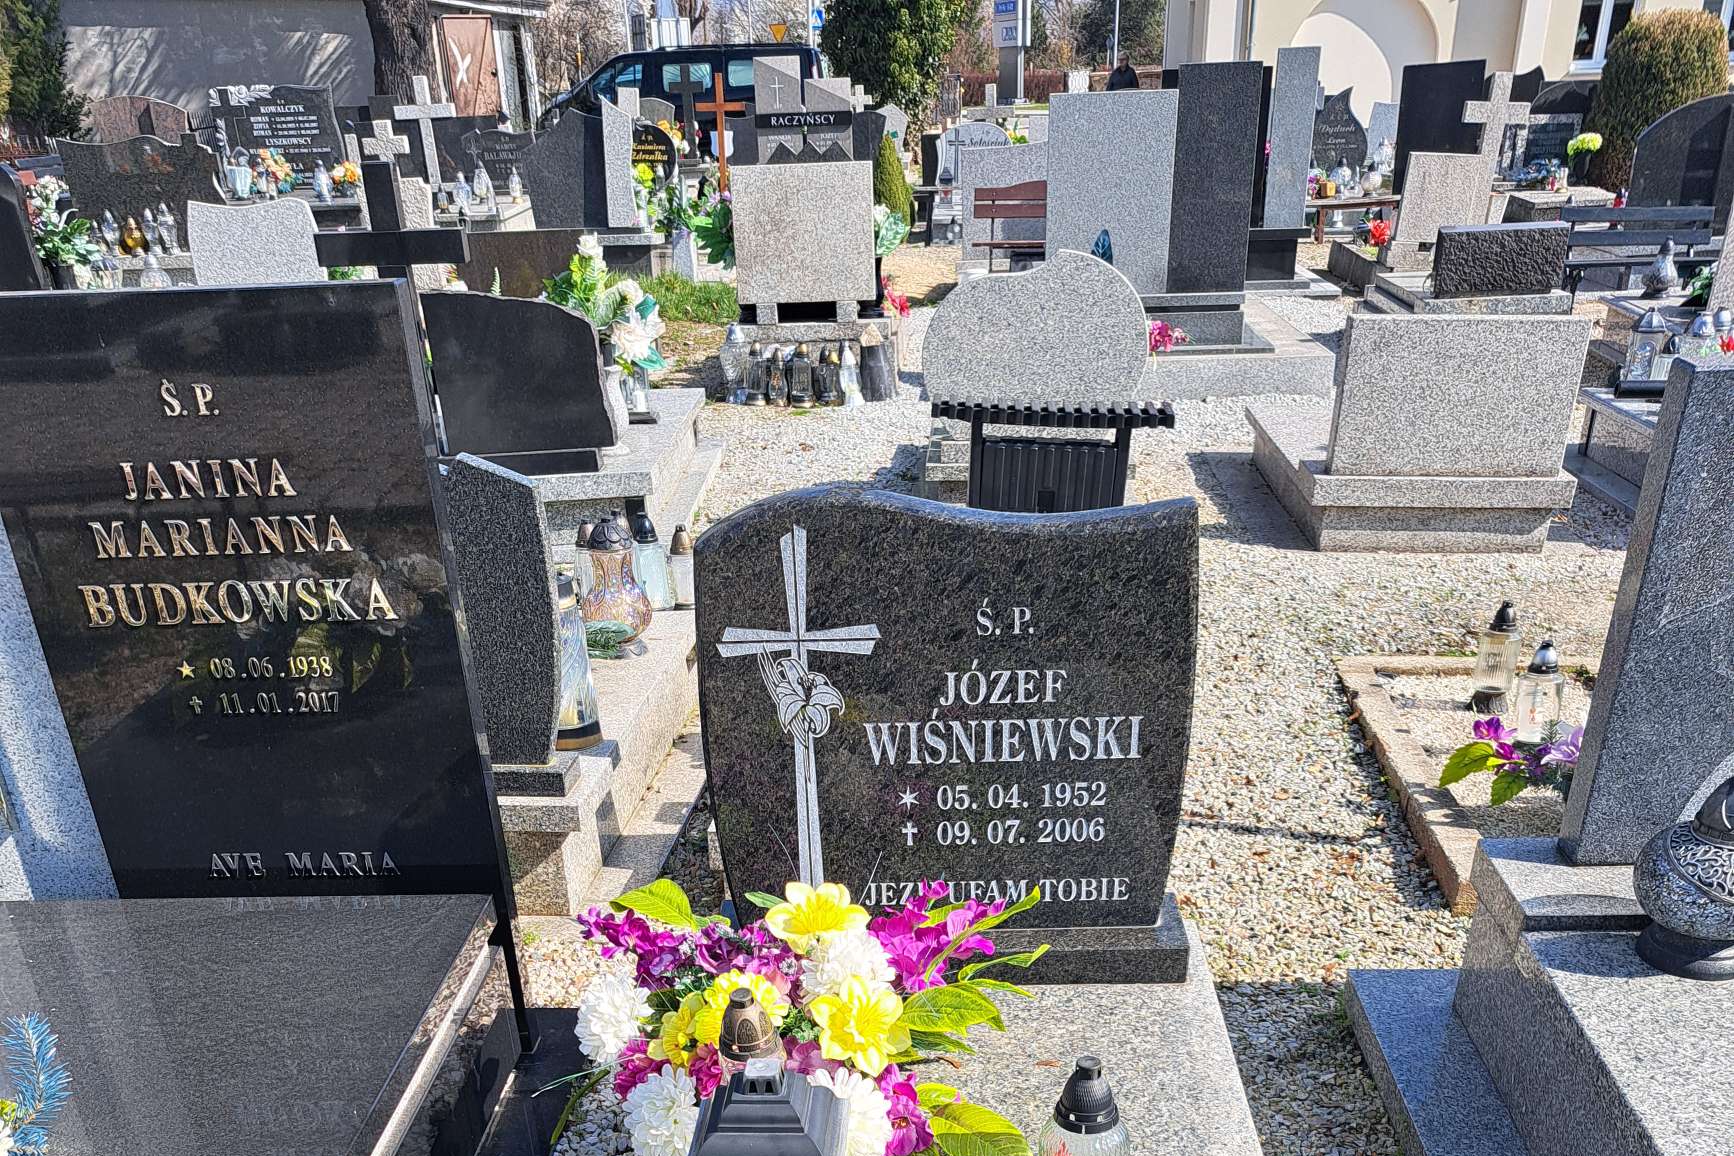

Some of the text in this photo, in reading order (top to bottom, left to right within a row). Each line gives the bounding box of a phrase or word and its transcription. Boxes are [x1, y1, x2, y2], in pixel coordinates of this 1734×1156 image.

[260, 105, 305, 114] KOWALCZYK
[770, 113, 836, 127] RACZYŃSCY
[119, 457, 298, 501] JANINA
[87, 514, 354, 560] MARIANNA
[78, 577, 399, 628] BUDKOWSKA
[939, 658, 1068, 706] JÓZEF
[863, 707, 1145, 766] WIŚNIEWSKI
[209, 851, 401, 878] AVE MARIA
[947, 879, 1030, 905] UFAM
[1039, 877, 1130, 903] TOBIE
